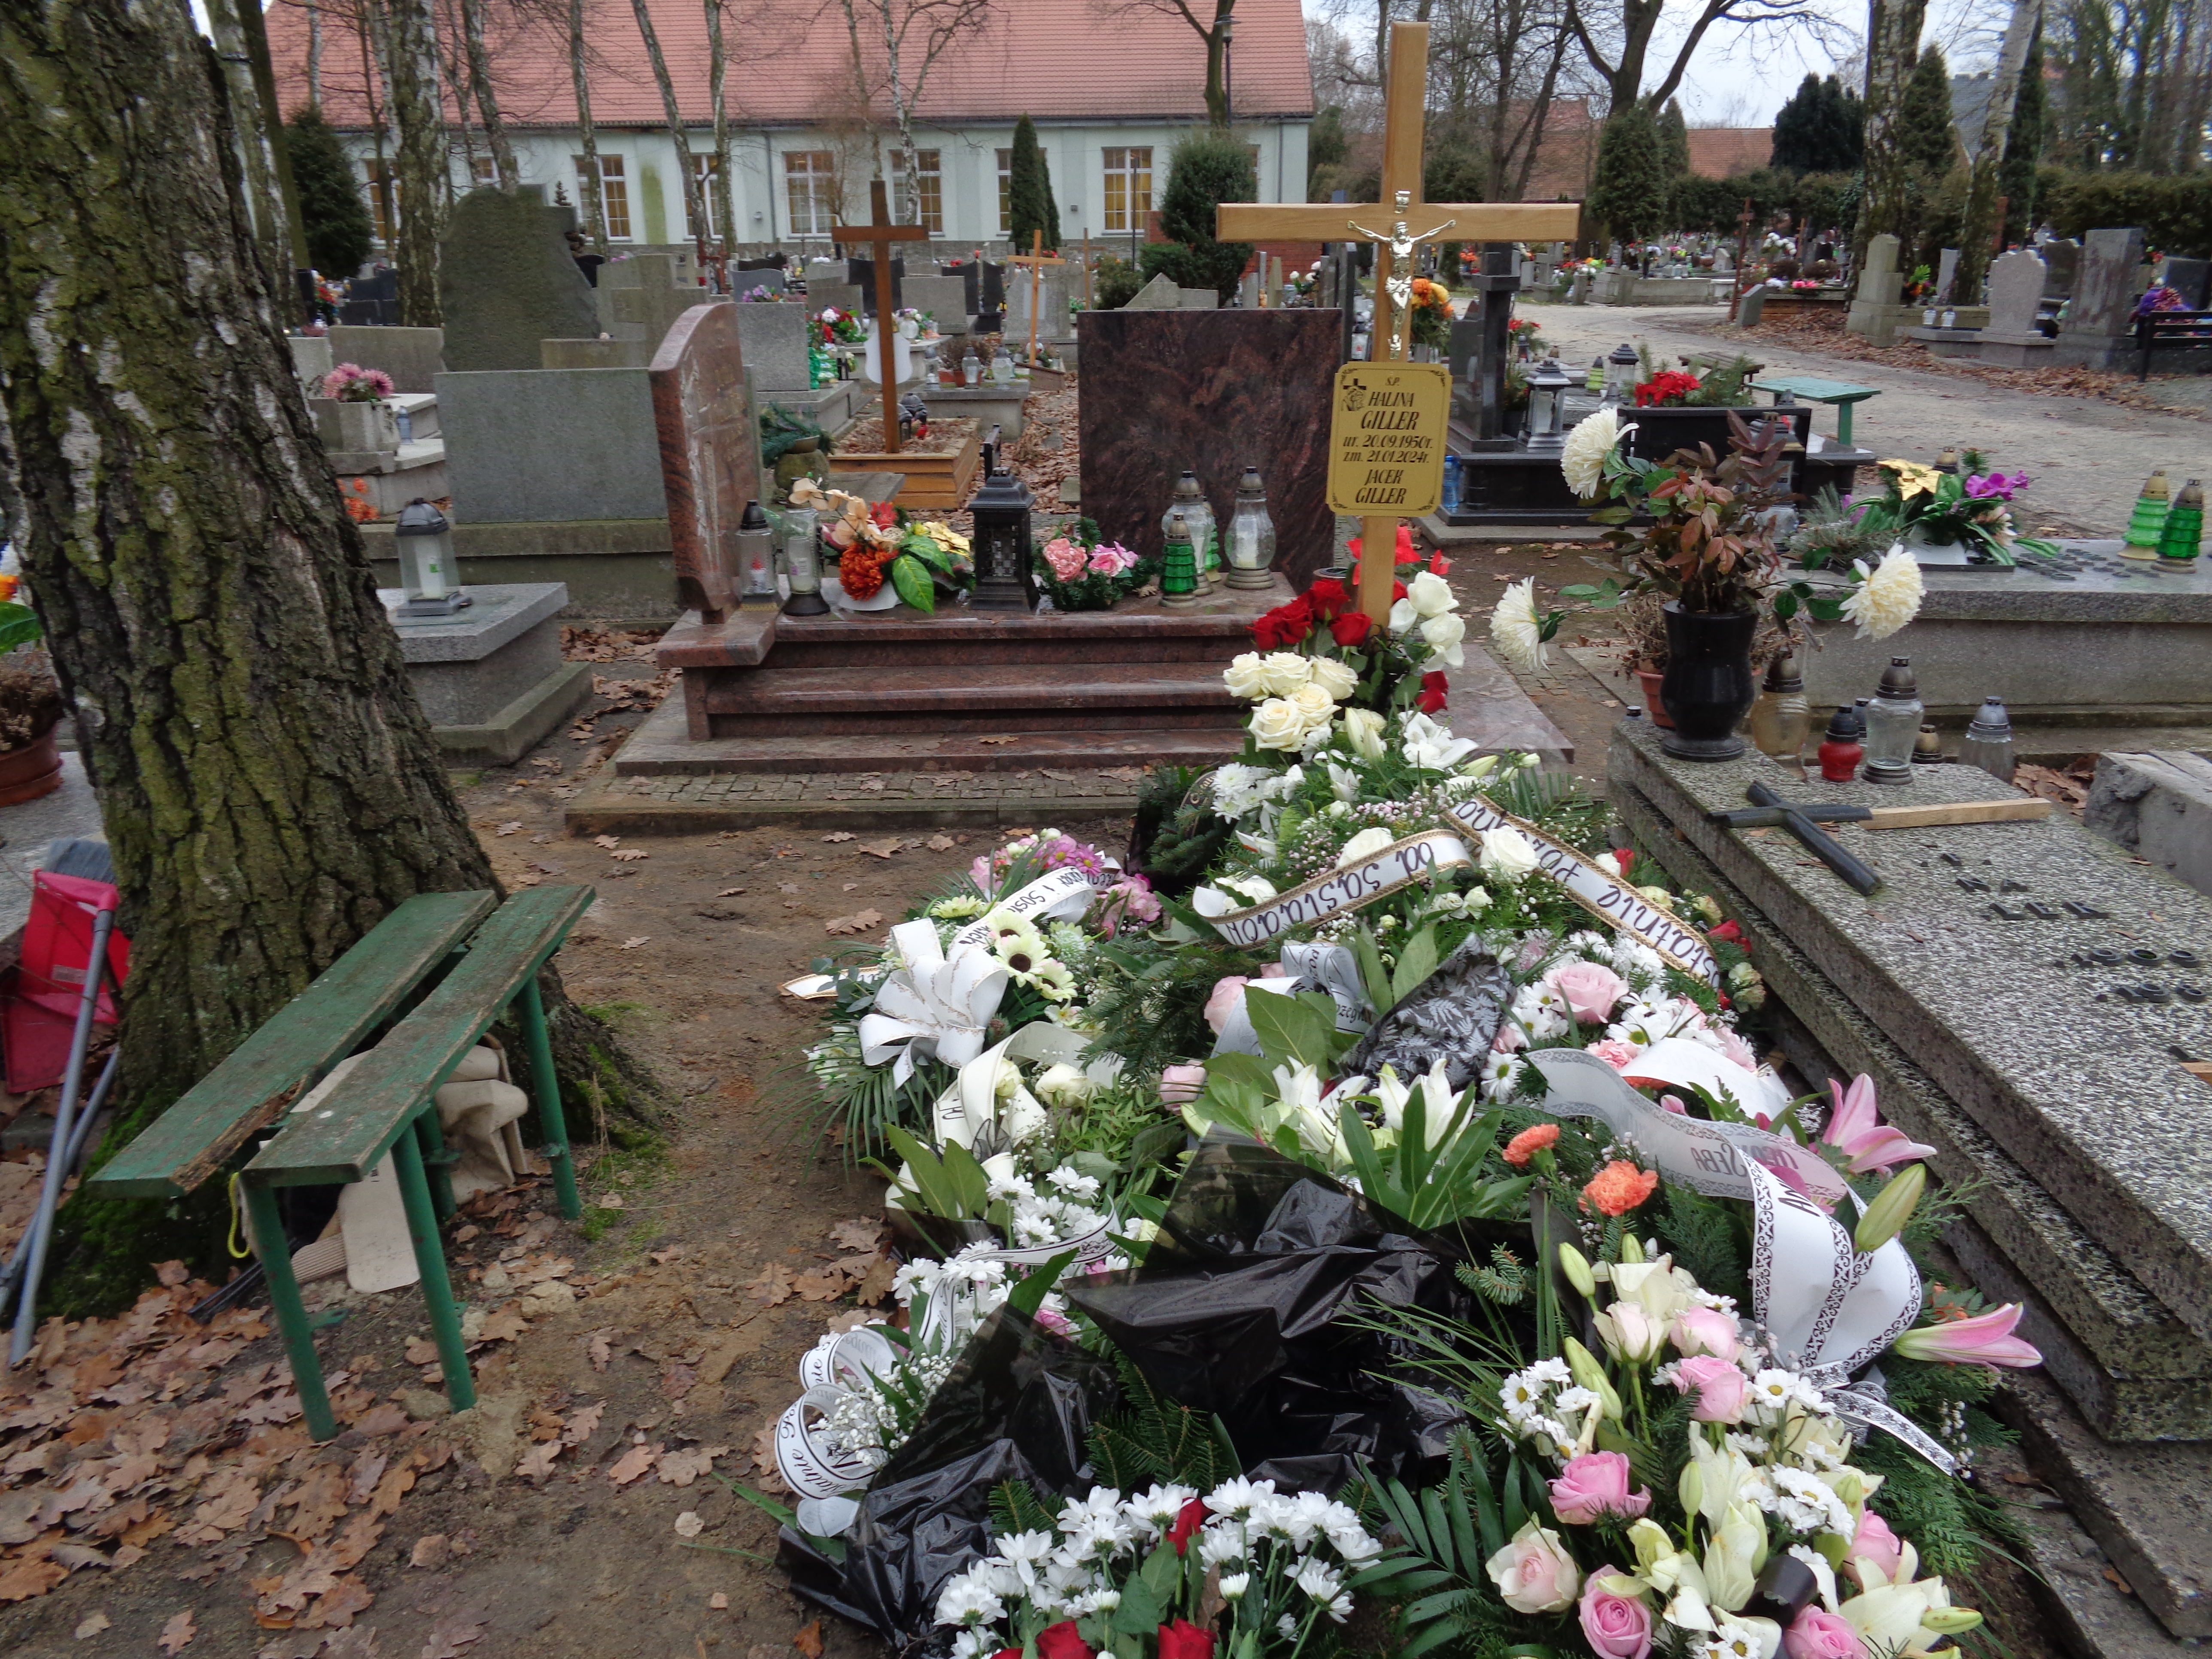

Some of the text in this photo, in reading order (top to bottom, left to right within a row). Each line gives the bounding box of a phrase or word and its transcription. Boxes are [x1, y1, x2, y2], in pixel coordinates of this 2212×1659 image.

[1368, 391, 1415, 407] HALINA
[1361, 410, 1420, 430] GILLER
[1364, 469, 1404, 486] JACEK
[1355, 487, 1407, 504] GILLER
